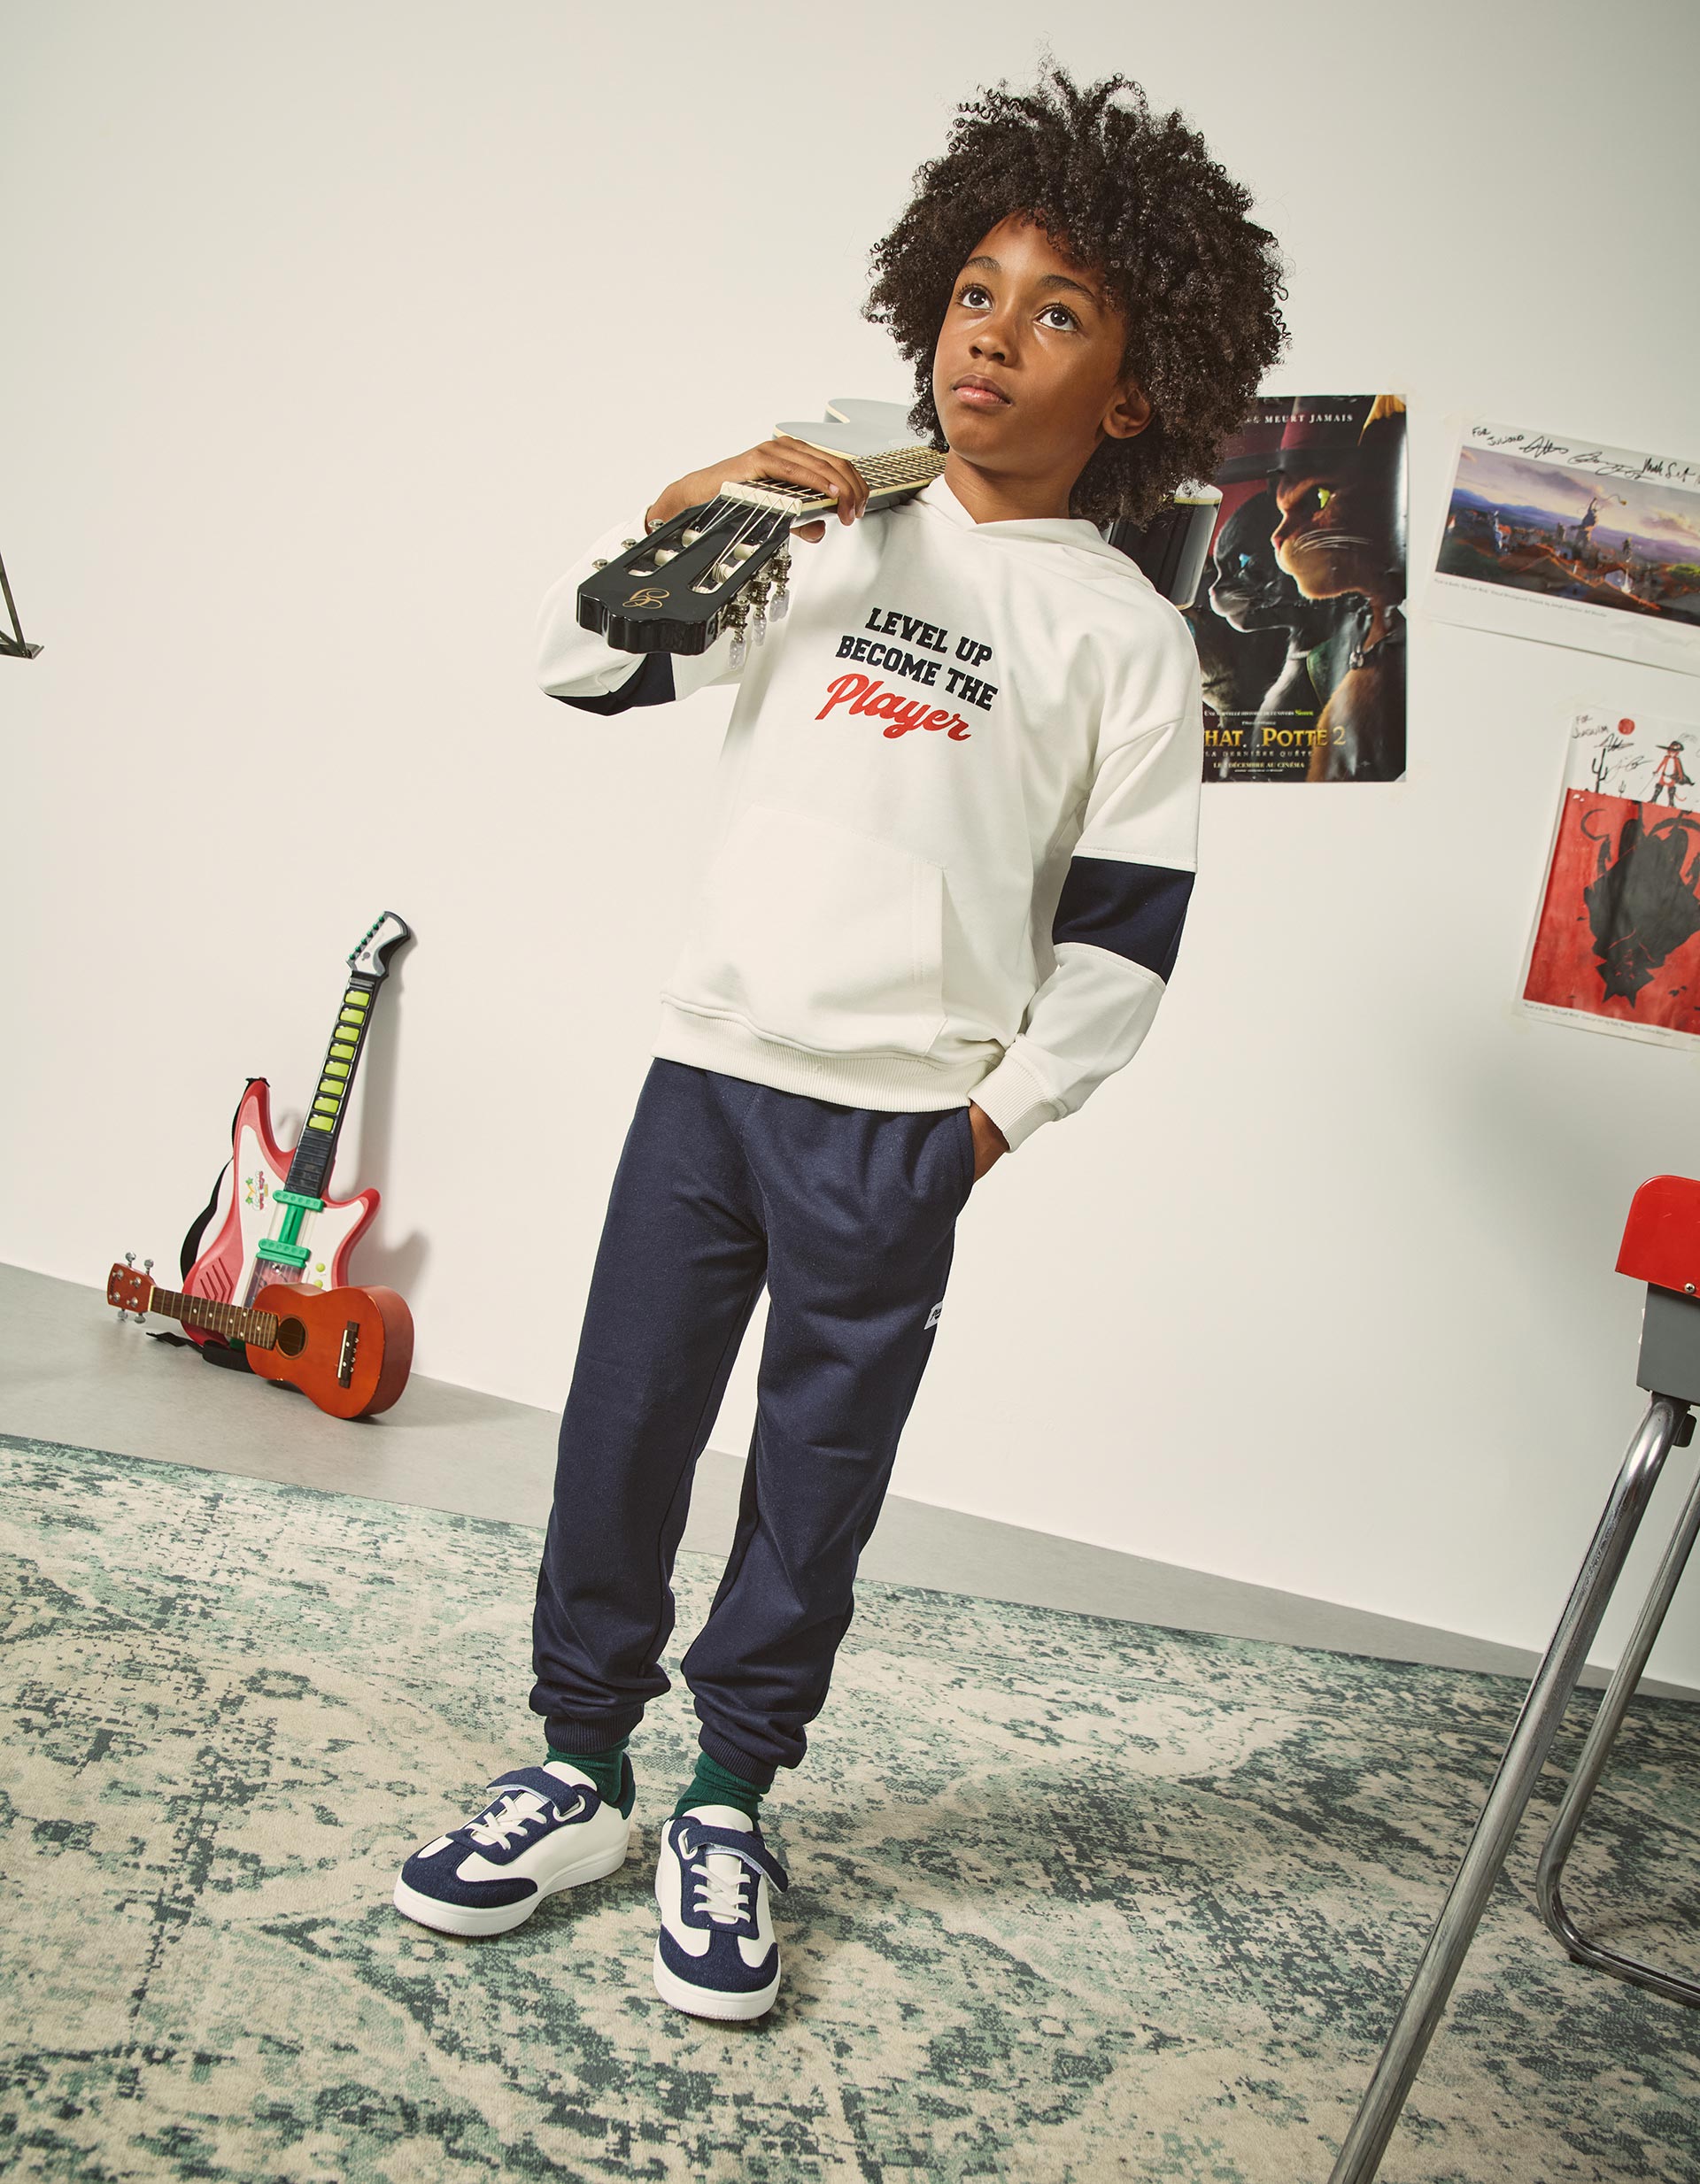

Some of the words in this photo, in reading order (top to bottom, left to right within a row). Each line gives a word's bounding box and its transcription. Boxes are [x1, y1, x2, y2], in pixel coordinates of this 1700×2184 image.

[1264, 414, 1305, 424] MEURT
[1309, 413, 1354, 424] JAMAIS
[864, 607, 948, 654] LEVEL
[954, 636, 993, 668] UP
[835, 635, 942, 687] BECOME
[945, 667, 999, 712] THE
[815, 673, 971, 742] Player
[1204, 729, 1243, 746] HAT
[1333, 725, 1346, 745] 2
